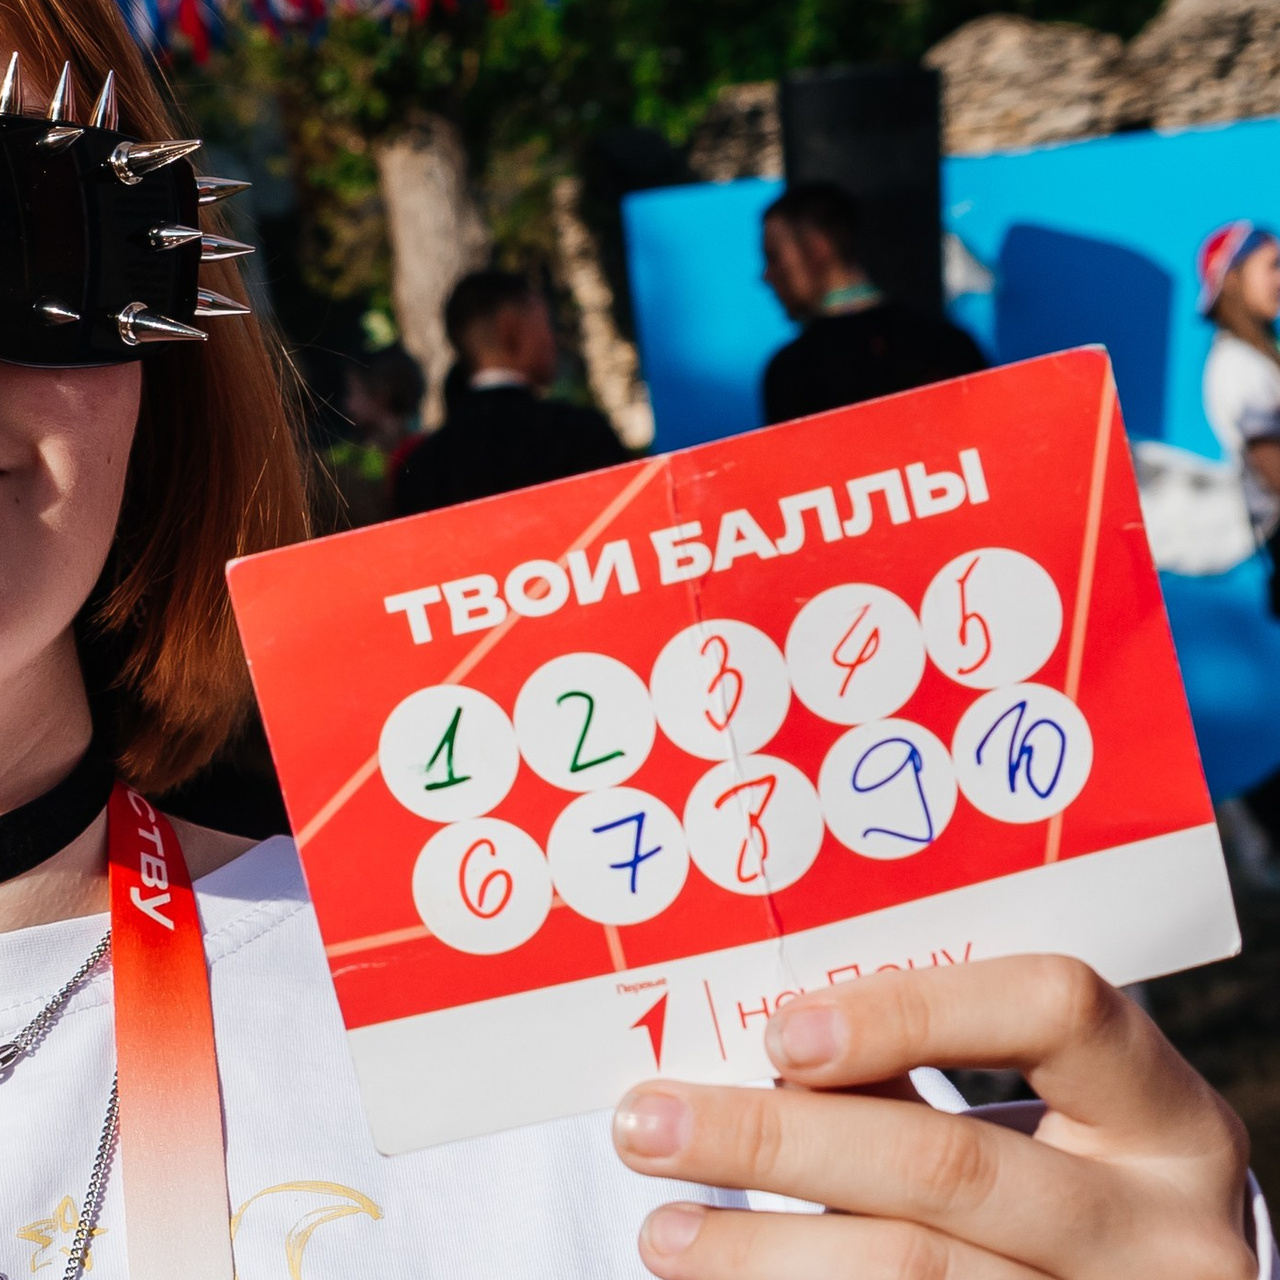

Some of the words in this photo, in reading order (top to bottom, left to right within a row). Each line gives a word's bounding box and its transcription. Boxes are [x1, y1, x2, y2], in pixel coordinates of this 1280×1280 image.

[385, 540, 640, 645] ТВОИ
[650, 448, 989, 586] БАЛЛЫ
[424, 706, 471, 790] 1
[557, 692, 625, 773] 2
[700, 635, 744, 732] 3
[832, 603, 880, 698] 4
[956, 556, 991, 676] 5
[459, 838, 513, 919] 6
[592, 811, 662, 894] 7
[852, 737, 933, 843] 9
[976, 700, 1066, 799] 10
